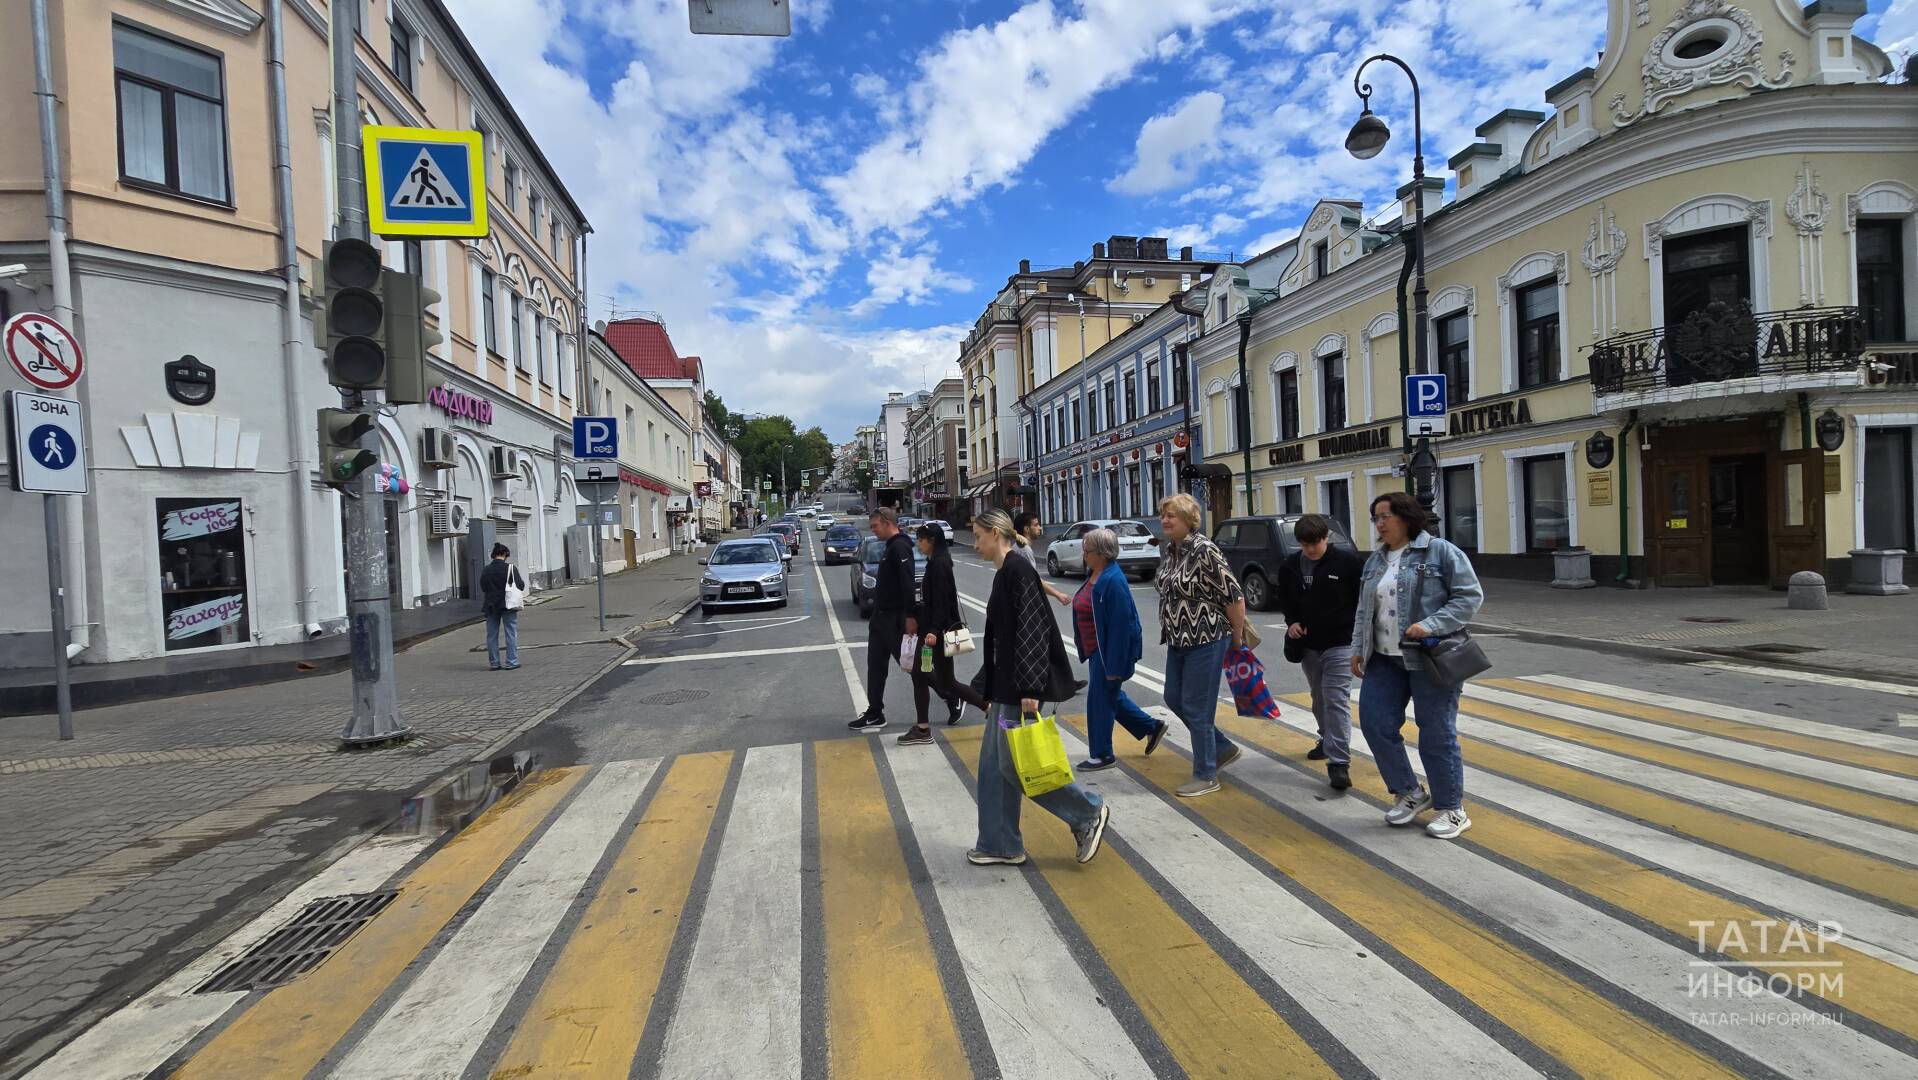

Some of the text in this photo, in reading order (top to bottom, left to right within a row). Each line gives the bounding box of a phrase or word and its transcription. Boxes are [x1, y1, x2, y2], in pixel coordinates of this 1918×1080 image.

[30, 399, 69, 416] ЗОНА
[1449, 397, 1533, 436] АПТЕКА
[172, 599, 241, 630] Заходи
